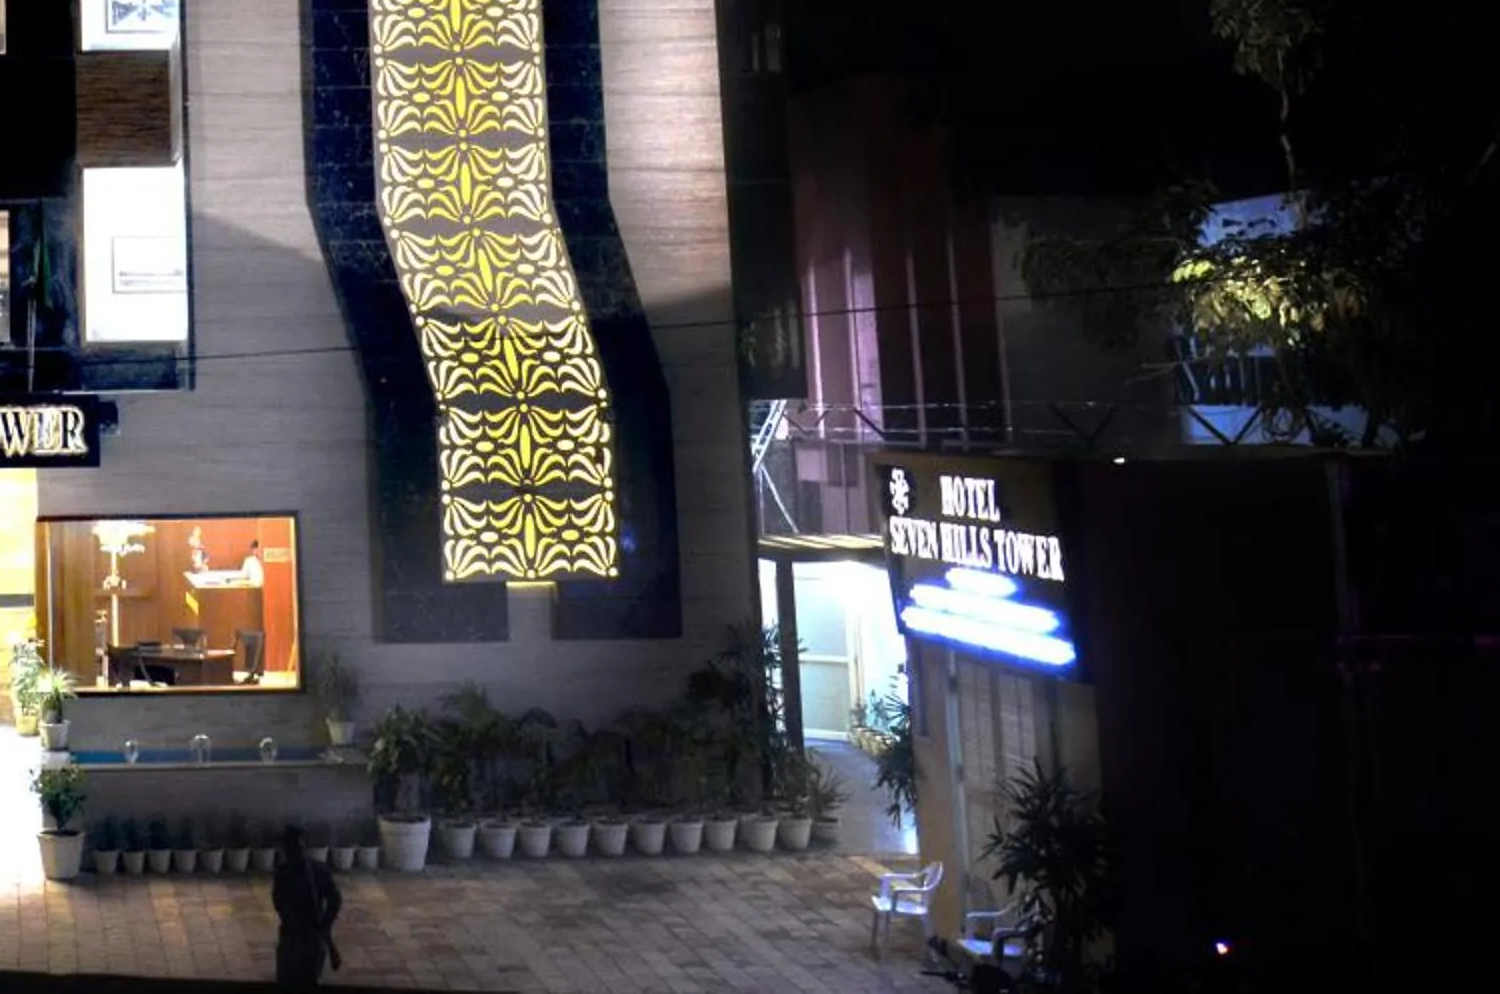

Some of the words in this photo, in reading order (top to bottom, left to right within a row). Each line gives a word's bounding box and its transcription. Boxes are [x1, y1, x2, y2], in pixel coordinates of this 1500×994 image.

[940, 475, 1000, 522] HOTEL
[889, 515, 938, 560] SEVEN
[940, 521, 993, 568] HILLS
[993, 529, 1065, 582] TOWER
